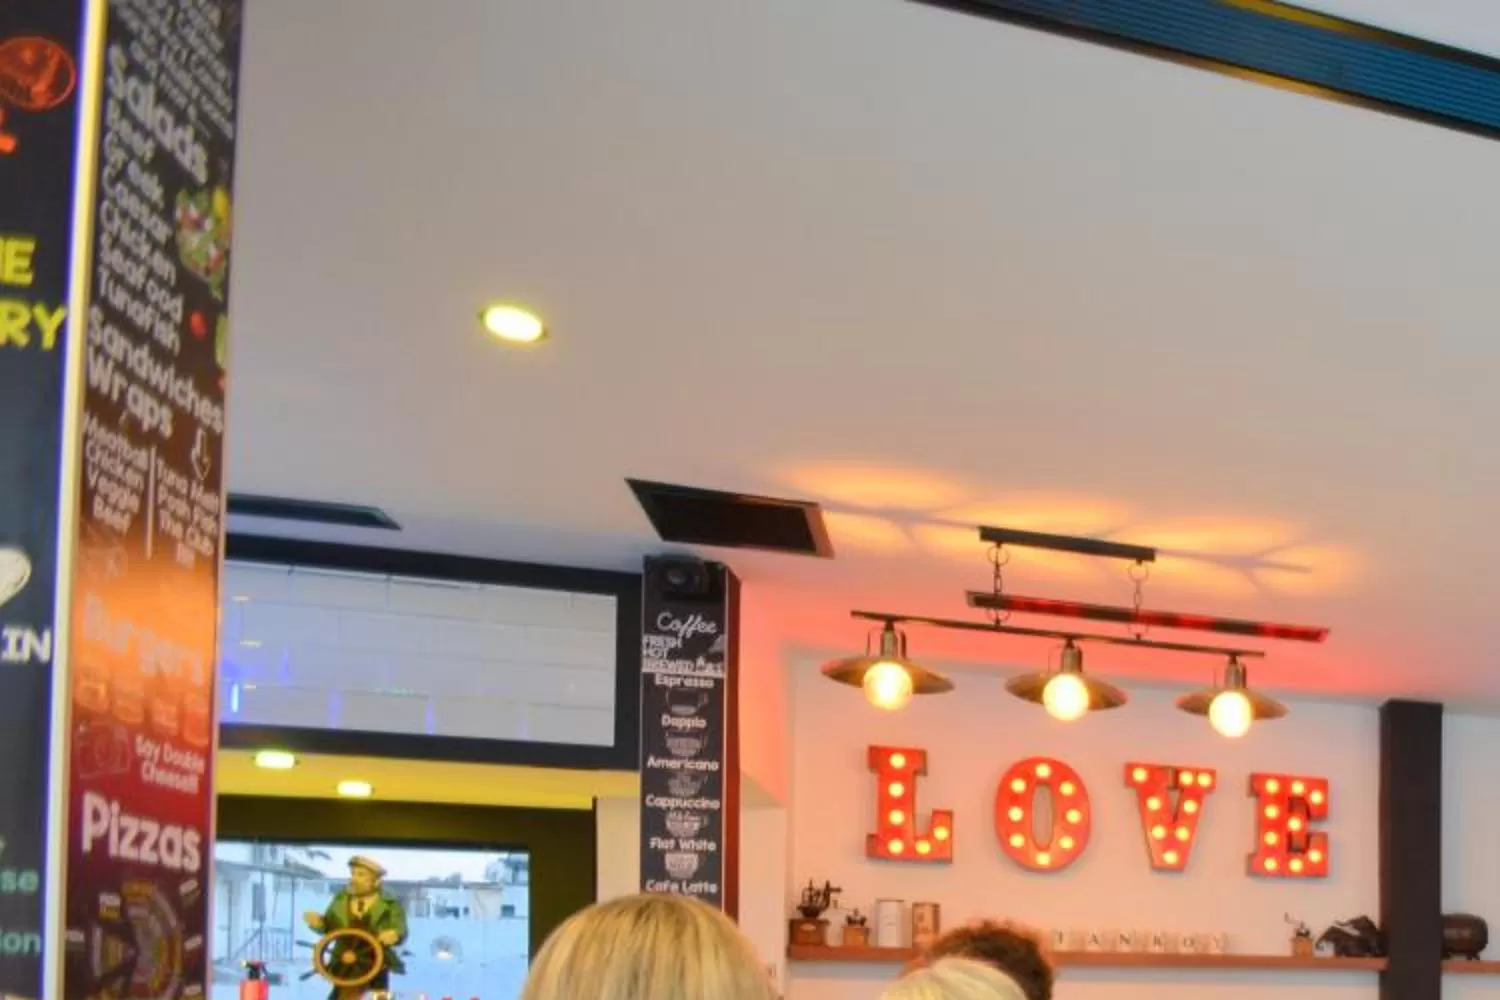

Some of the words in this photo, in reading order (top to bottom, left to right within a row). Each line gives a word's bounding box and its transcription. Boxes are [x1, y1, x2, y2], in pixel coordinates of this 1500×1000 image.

[108, 43, 208, 185] Salads
[0, 237, 35, 285] E
[88, 304, 223, 435] Sandwiches
[88, 345, 173, 440] Wraps
[657, 611, 717, 639] Coffee
[655, 674, 714, 688] Espresso
[661, 714, 707, 731] Doppio
[647, 756, 719, 771] Americano
[645, 795, 720, 810] Cappuccino
[867, 745, 1329, 877] LOVE
[82, 790, 200, 873] Pizzas
[0, 932, 41, 955] on
